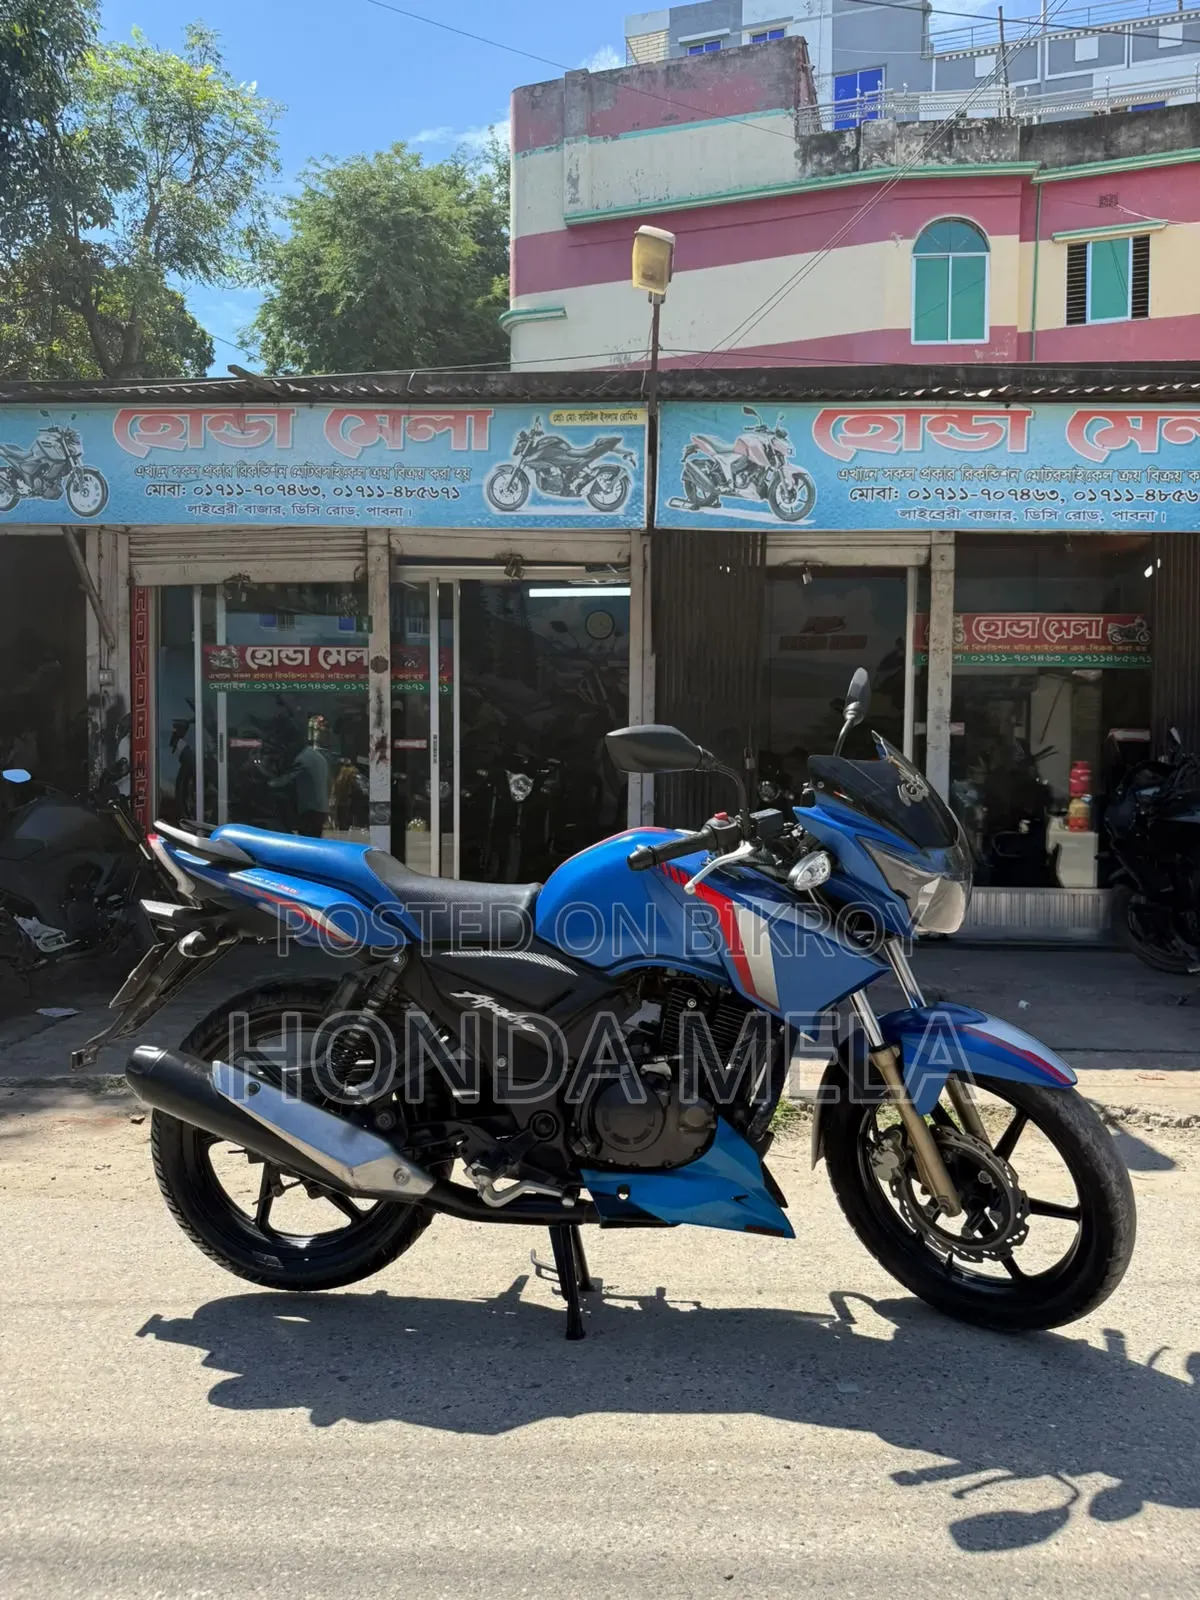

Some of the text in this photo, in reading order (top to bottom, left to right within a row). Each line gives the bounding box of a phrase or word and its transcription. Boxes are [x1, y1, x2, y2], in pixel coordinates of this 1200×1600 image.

[113, 407, 494, 460] হোন্ডা মেলা
[812, 407, 1200, 463] হোন্ডা মেল
[135, 464, 168, 479] এখানে
[172, 465, 200, 479] সকল
[202, 464, 232, 479] প্রকার
[394, 463, 426, 481] বিক্রয়
[429, 467, 450, 481] করা
[453, 467, 471, 483] হয়
[837, 466, 880, 481] এখানে
[883, 466, 916, 481] সকল
[919, 466, 958, 481] প্রকার
[1024, 464, 1114, 485] মোটরসাইকেল
[1146, 466, 1184, 484] বিক্রয়
[193, 483, 326, 499] ০১৭১১-৭০৭৪৬৩,
[333, 484, 460, 500] ০১৭১১-৪৮৫৬৭১
[907, 487, 1065, 504] ০১৭১১-৭০৭৪৬৩,
[1074, 488, 1199, 502] ০১৭১১-৪৮৫৬
[187, 502, 238, 516] লাইব্রেরী
[244, 504, 286, 516] বাজার,
[292, 503, 321, 516] ডিসি
[326, 505, 360, 518] রোড,
[898, 506, 961, 521] লাইব্রেরী
[967, 509, 1018, 522] বাজার,
[1025, 508, 1059, 522] ডিসি
[1065, 511, 1105, 523] রোড,
[972, 616, 1103, 643] হোন্ডা মেলা
[245, 646, 369, 671] হোন্ডা মেল
[450, 991, 538, 1032] Apache
